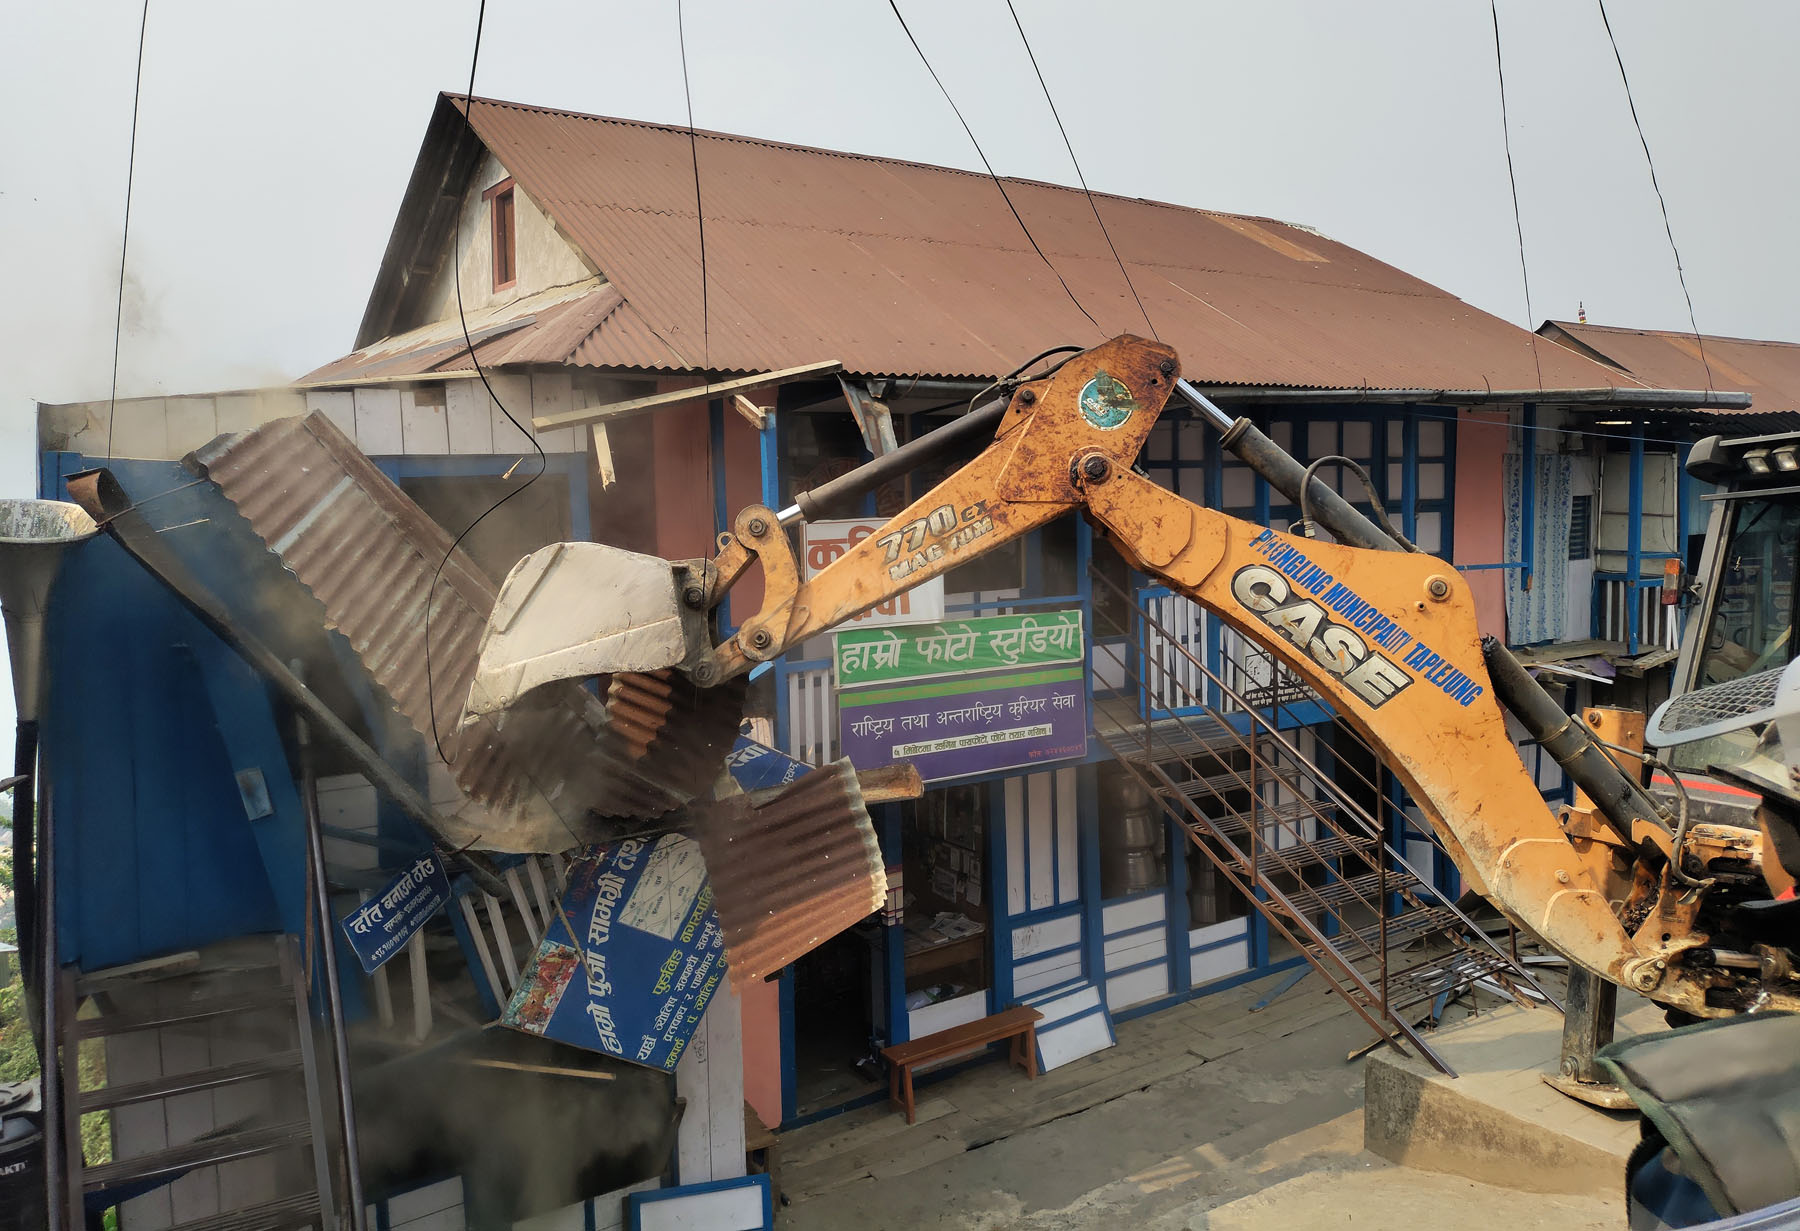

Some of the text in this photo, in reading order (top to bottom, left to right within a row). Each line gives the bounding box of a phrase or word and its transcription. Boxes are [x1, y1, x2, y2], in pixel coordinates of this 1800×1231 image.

[876, 504, 958, 565] 770
[841, 615, 1079, 674] हाम्रो फोटो स्टुडियो
[1231, 563, 1415, 711] CASE
[1402, 642, 1483, 707] TAPLEJUNG
[901, 713, 930, 731] तथा
[1052, 691, 1076, 711] सेवा
[349, 903, 384, 934] दाँत
[586, 1000, 624, 1055] हाम्रो
